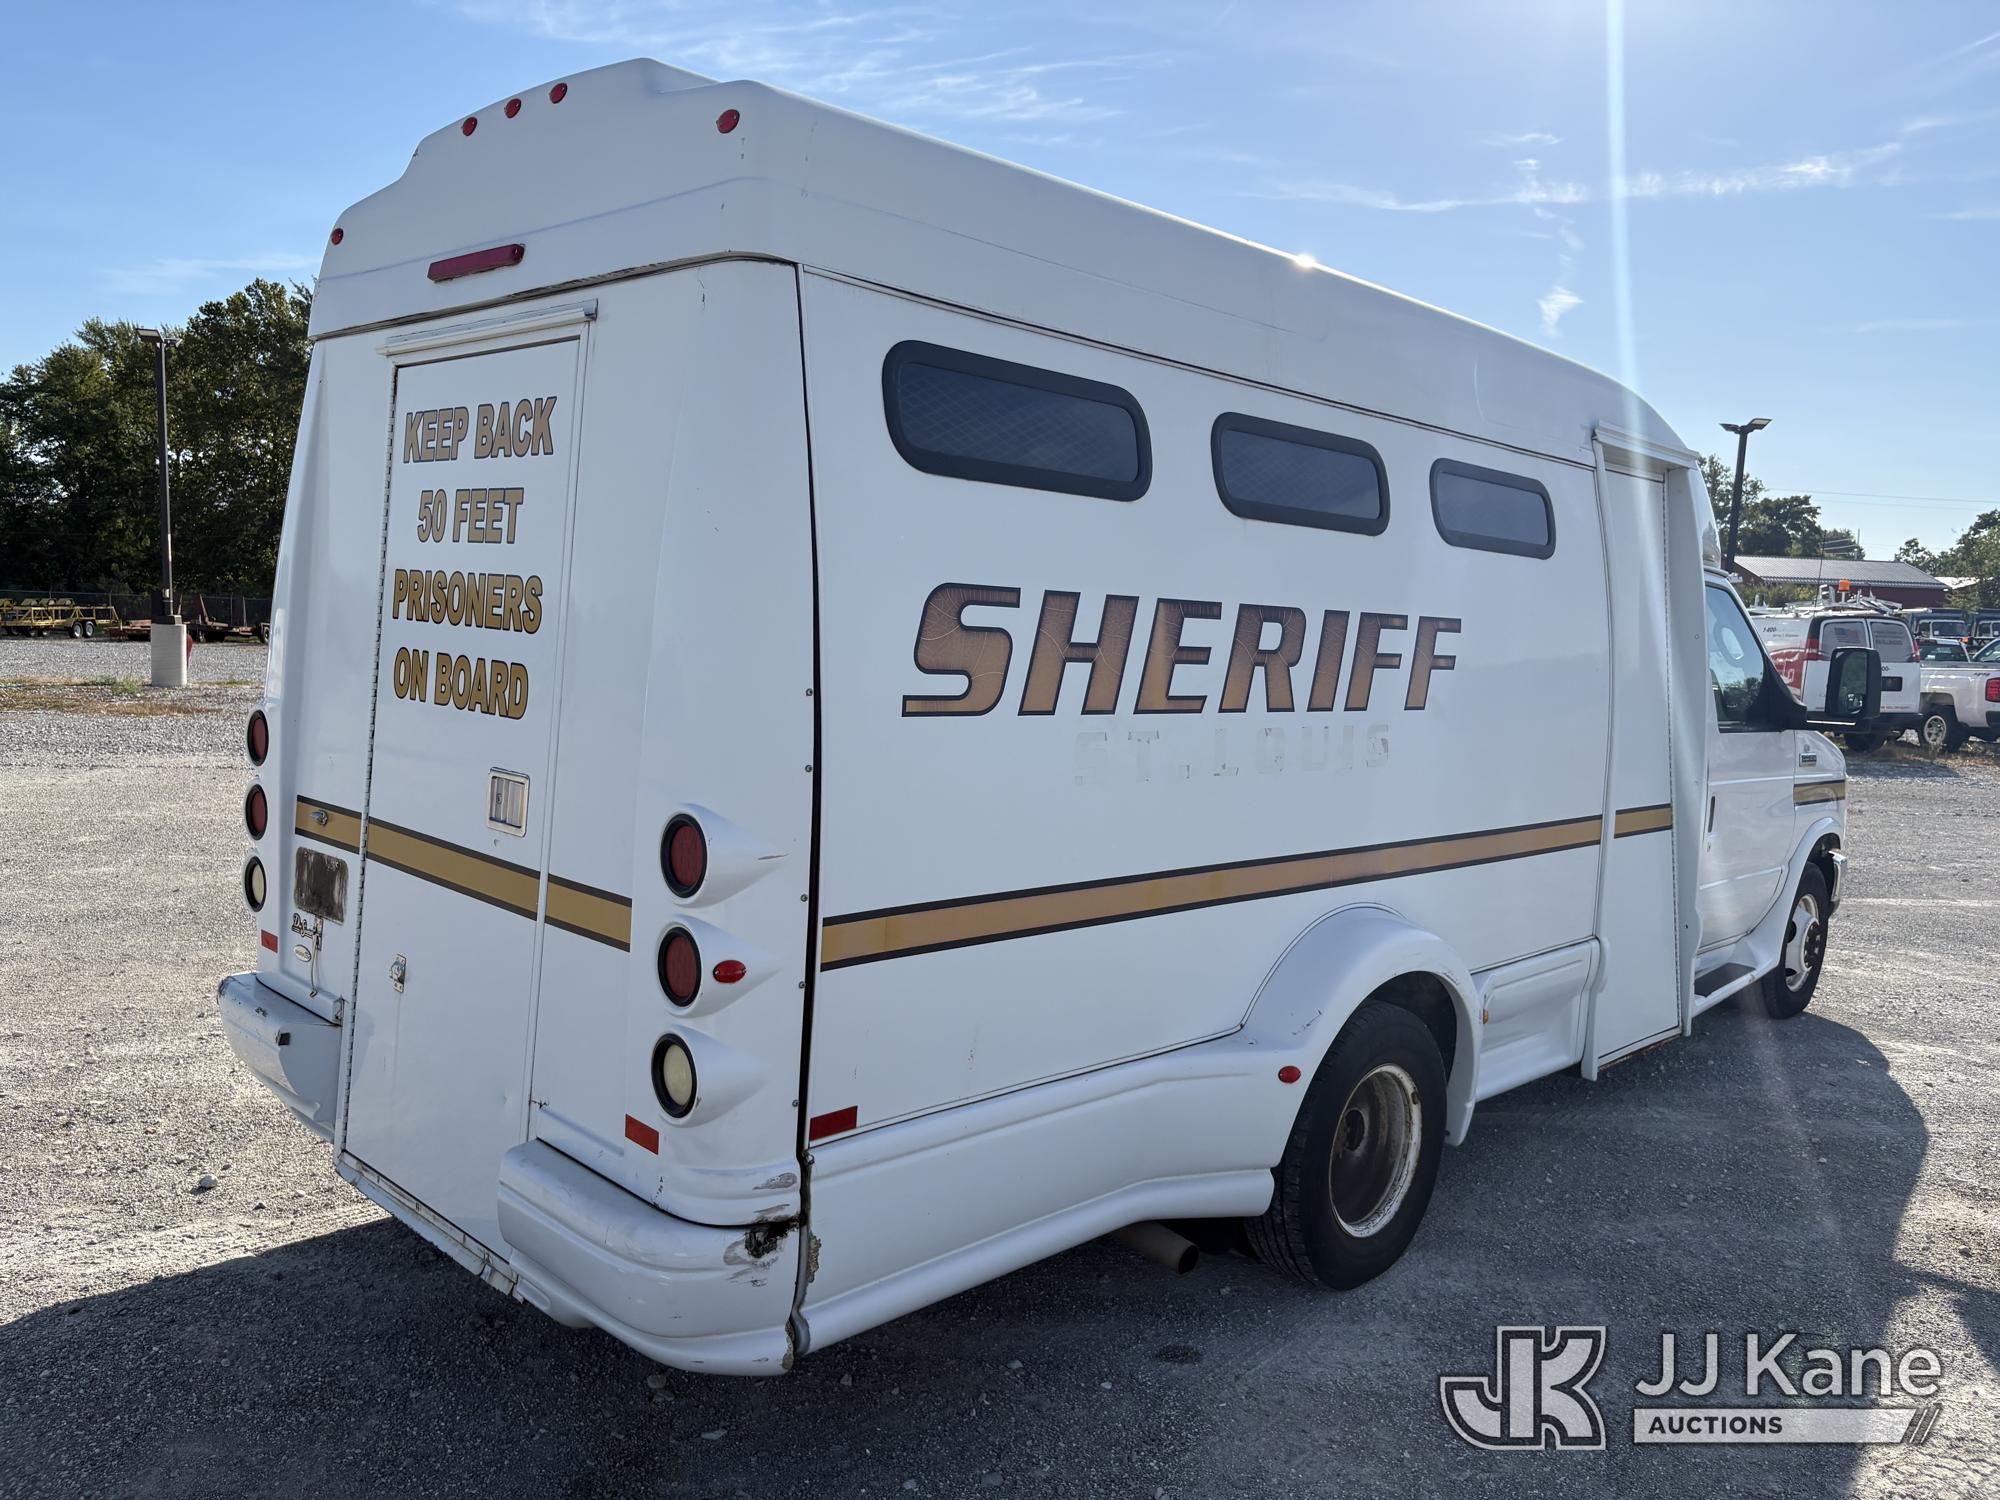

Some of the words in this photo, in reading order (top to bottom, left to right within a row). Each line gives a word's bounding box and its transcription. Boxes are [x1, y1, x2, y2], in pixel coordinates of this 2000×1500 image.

[403, 406, 469, 463] KEEP
[474, 396, 557, 459] BACK
[417, 489, 447, 542] 50
[452, 487, 524, 544] FEET
[392, 568, 543, 634] PRISONERS
[901, 582, 1462, 717] SHERIFF
[393, 647, 429, 702] ON
[434, 652, 529, 720] BOARD
